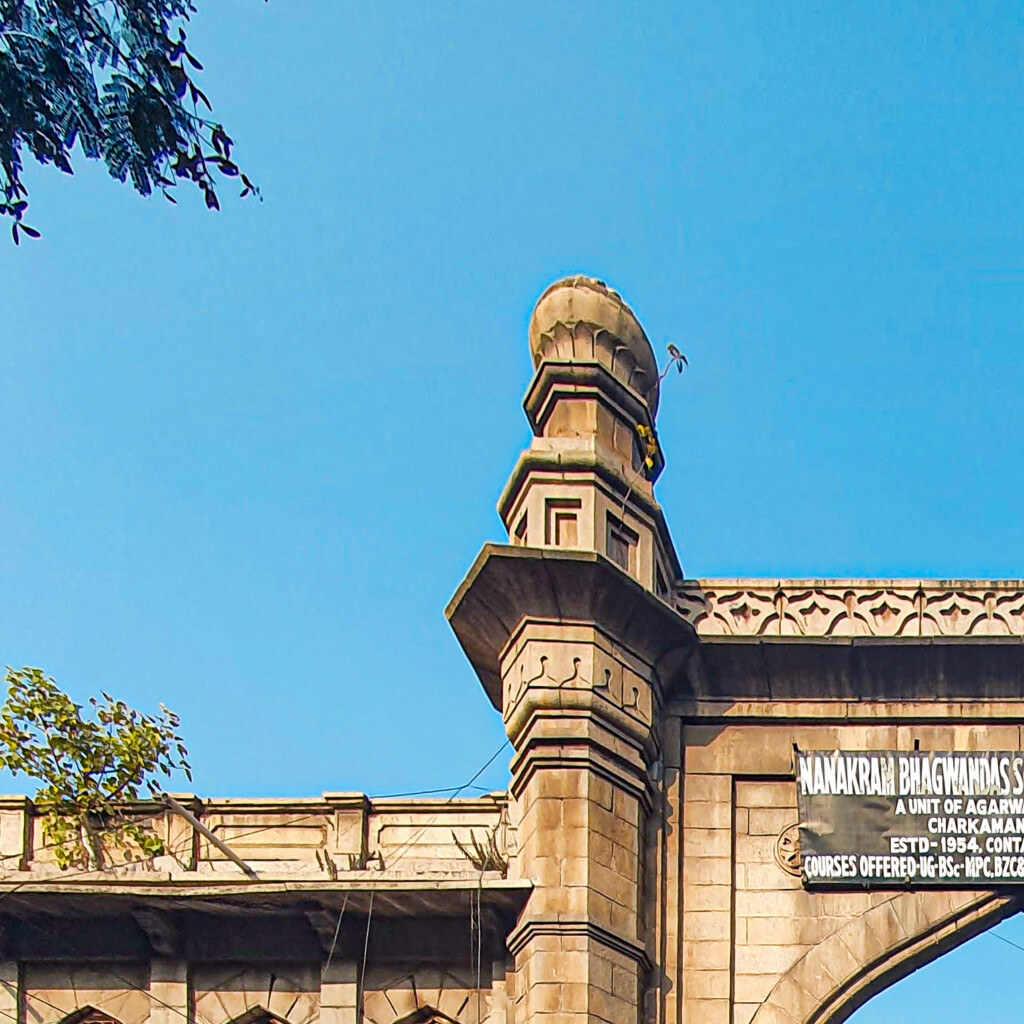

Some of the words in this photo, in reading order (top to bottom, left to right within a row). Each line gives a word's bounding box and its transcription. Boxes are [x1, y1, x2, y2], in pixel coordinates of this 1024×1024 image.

[800, 756, 896, 795] NANAKRAM
[899, 757, 1011, 796] BHAGWANDAS
[895, 799, 907, 815] A
[908, 799, 941, 815] UNIT
[944, 799, 963, 815] OF
[804, 855, 857, 878] COURSES
